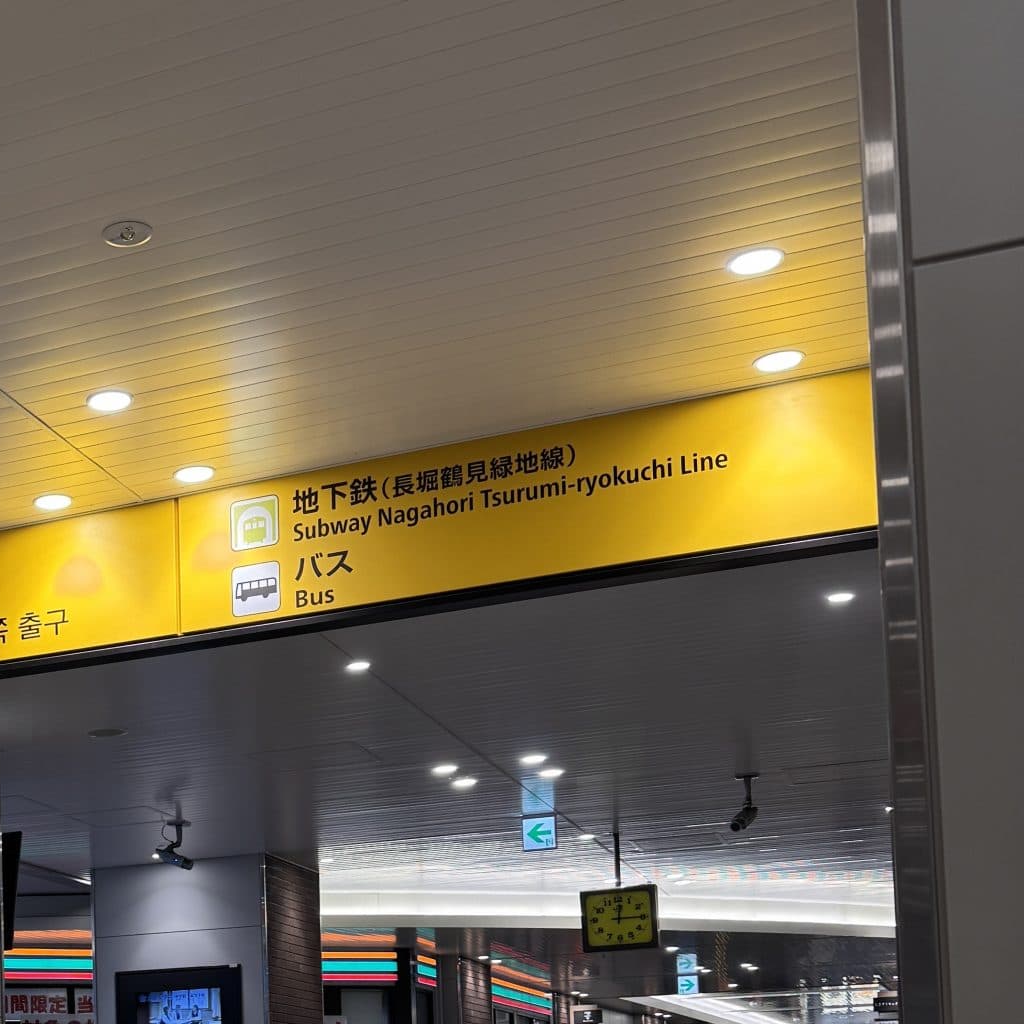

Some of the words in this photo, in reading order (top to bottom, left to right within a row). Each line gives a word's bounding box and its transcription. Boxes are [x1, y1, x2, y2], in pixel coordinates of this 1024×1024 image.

[292, 443, 577, 515] 地下鉄（長堀鶴見緑地線）
[292, 511, 372, 543] Subway
[377, 493, 475, 529] Nagahori
[480, 457, 673, 509] Tsurumi-ryokuchi
[680, 450, 729, 475] Line
[294, 550, 354, 582] バス
[295, 589, 335, 608] Bus
[18, 608, 70, 641] 출구
[5, 995, 67, 1014] 間限定
